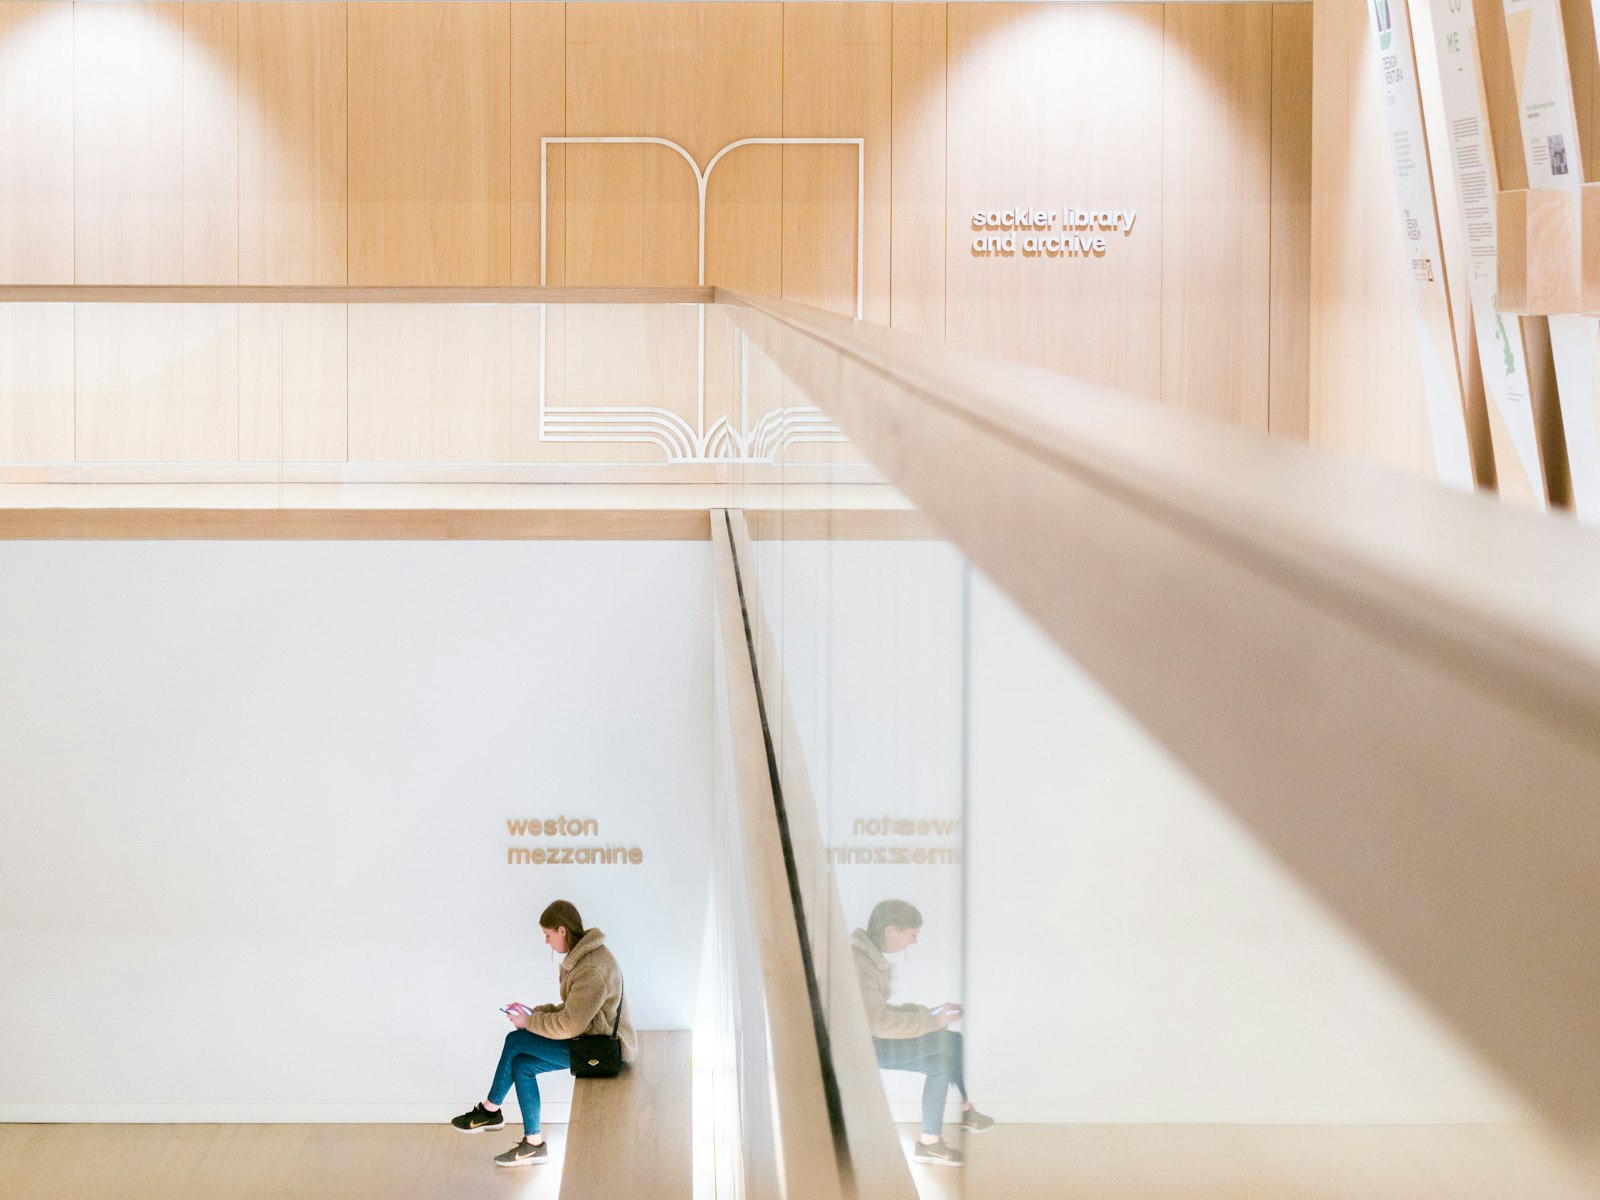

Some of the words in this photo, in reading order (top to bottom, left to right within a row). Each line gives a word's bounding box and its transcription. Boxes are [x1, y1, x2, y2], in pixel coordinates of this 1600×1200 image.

[1446, 31, 1460, 54] ME
[971, 206, 1056, 229] sackler
[1063, 206, 1136, 234] library
[971, 232, 1016, 255] and
[1022, 232, 1106, 255] archive
[507, 815, 599, 837] weston
[507, 843, 643, 865] mezzanine
